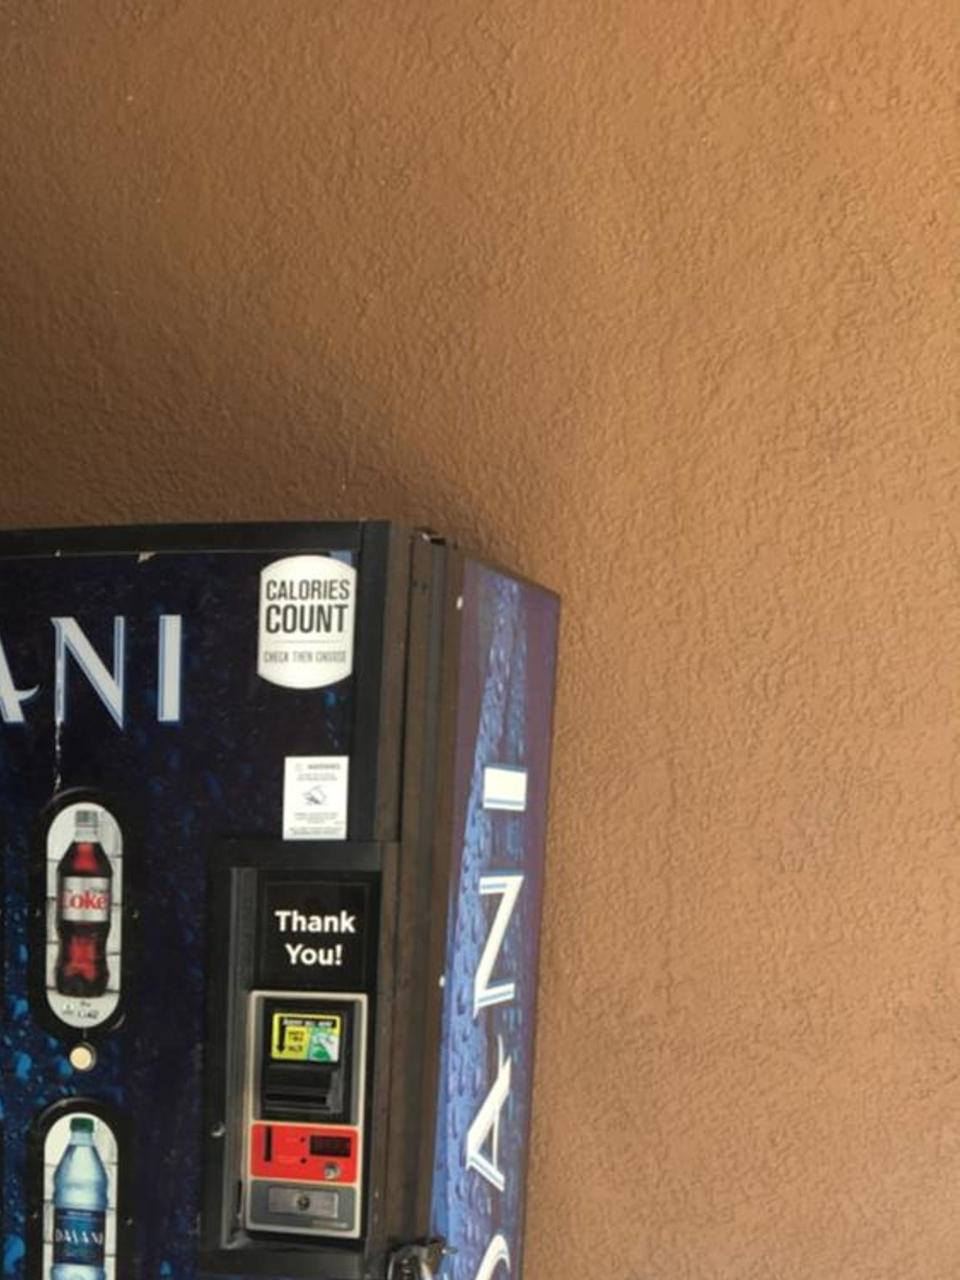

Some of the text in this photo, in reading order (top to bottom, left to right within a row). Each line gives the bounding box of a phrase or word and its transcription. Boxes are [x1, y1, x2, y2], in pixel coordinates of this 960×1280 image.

[266, 579, 350, 601] CALORIES
[265, 604, 349, 633] COUNT
[274, 910, 356, 933] Thank
[284, 943, 342, 966] You!
